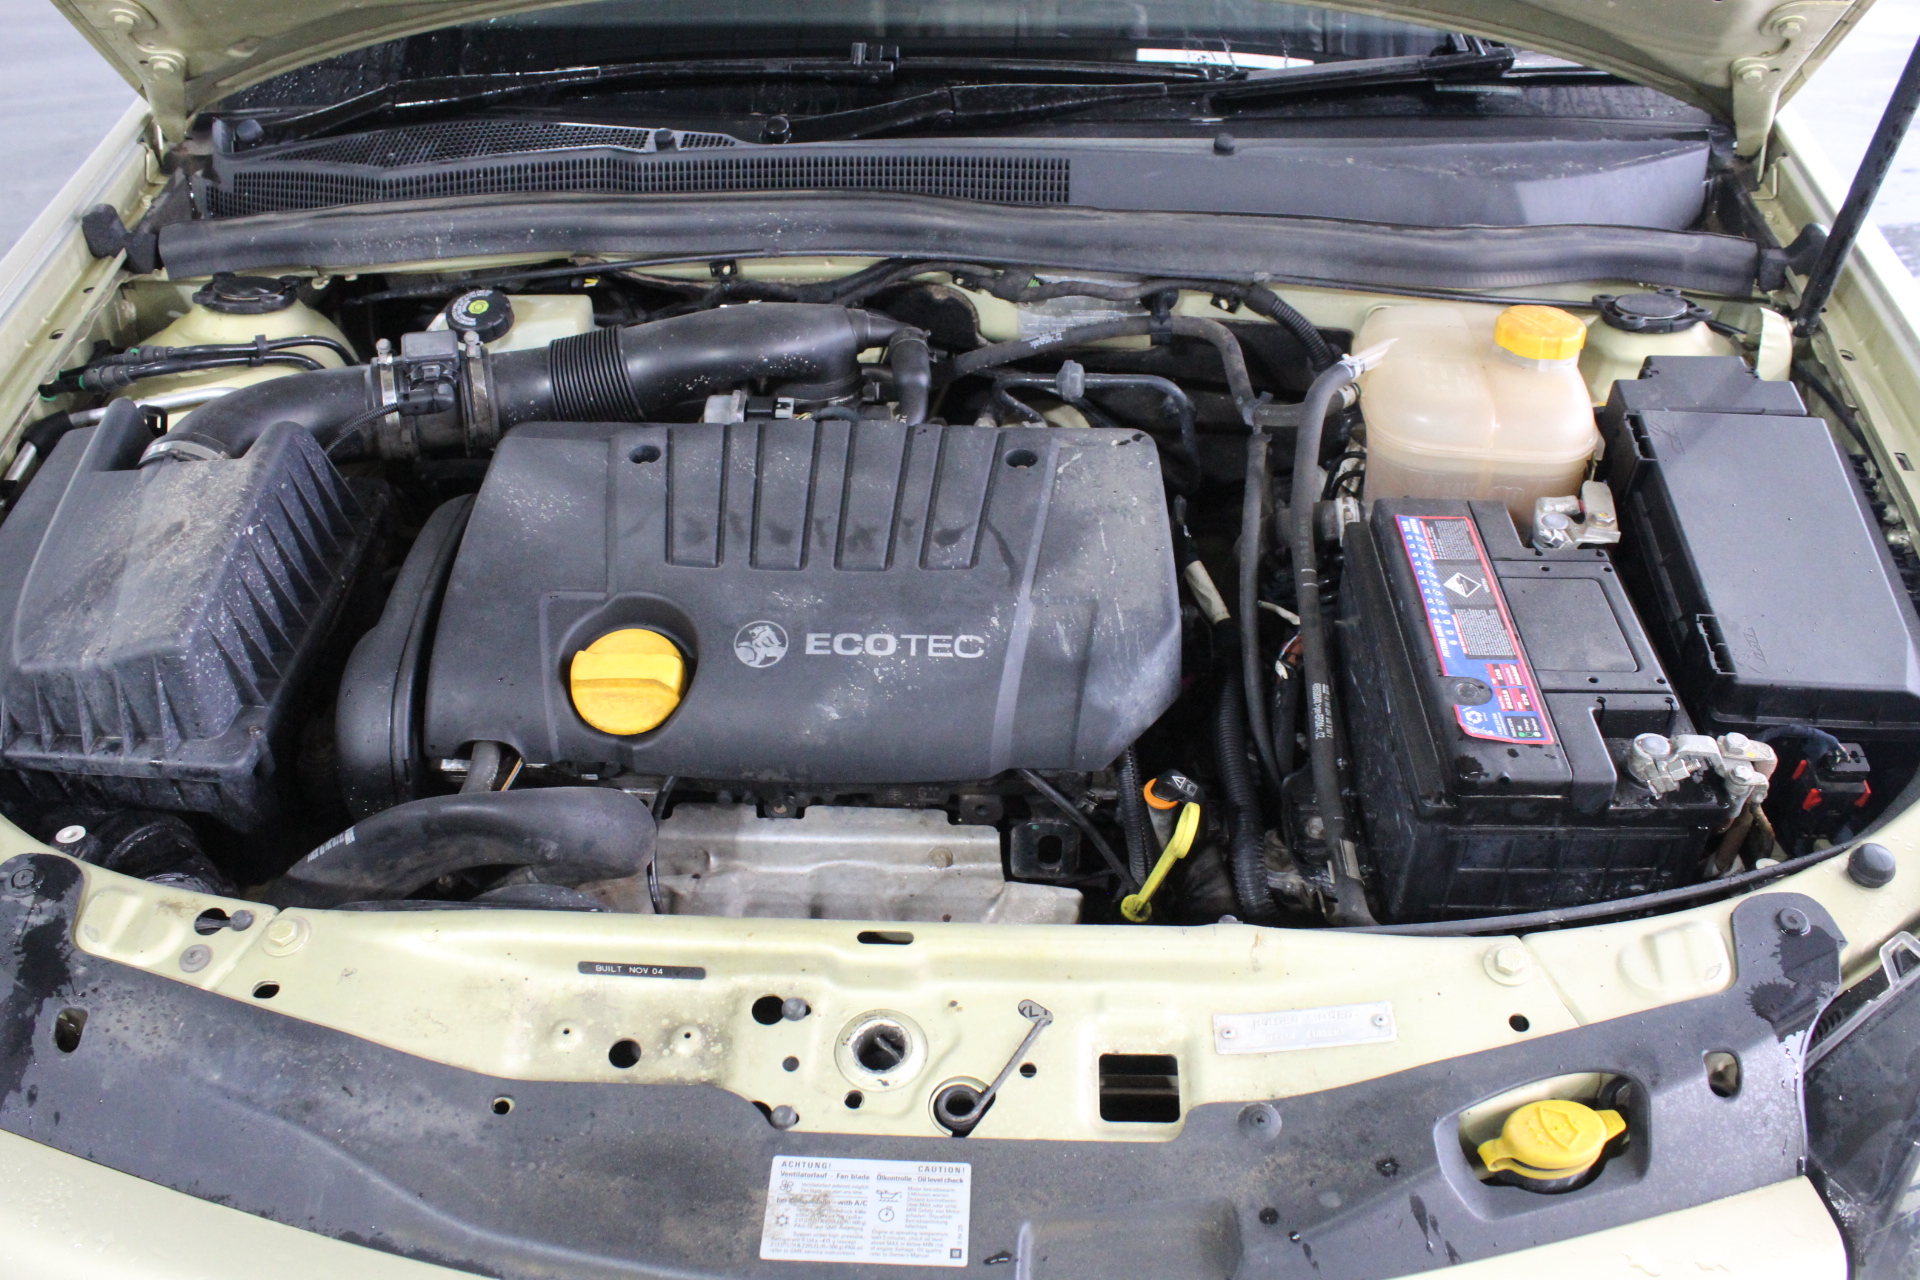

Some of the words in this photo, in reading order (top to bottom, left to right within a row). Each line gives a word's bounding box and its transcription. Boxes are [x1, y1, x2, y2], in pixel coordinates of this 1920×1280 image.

[805, 632, 985, 659] ECOTEC
[595, 964, 622, 973] BUILT
[629, 966, 649, 974] NOV
[652, 967, 663, 975] 04
[782, 1160, 831, 1169] ACHTUNG!
[918, 1165, 965, 1174] CAUTION!
[781, 1171, 827, 1179] Ventilatorlauf
[836, 1172, 848, 1180] Fan
[877, 1173, 912, 1182] Ölkontrolle
